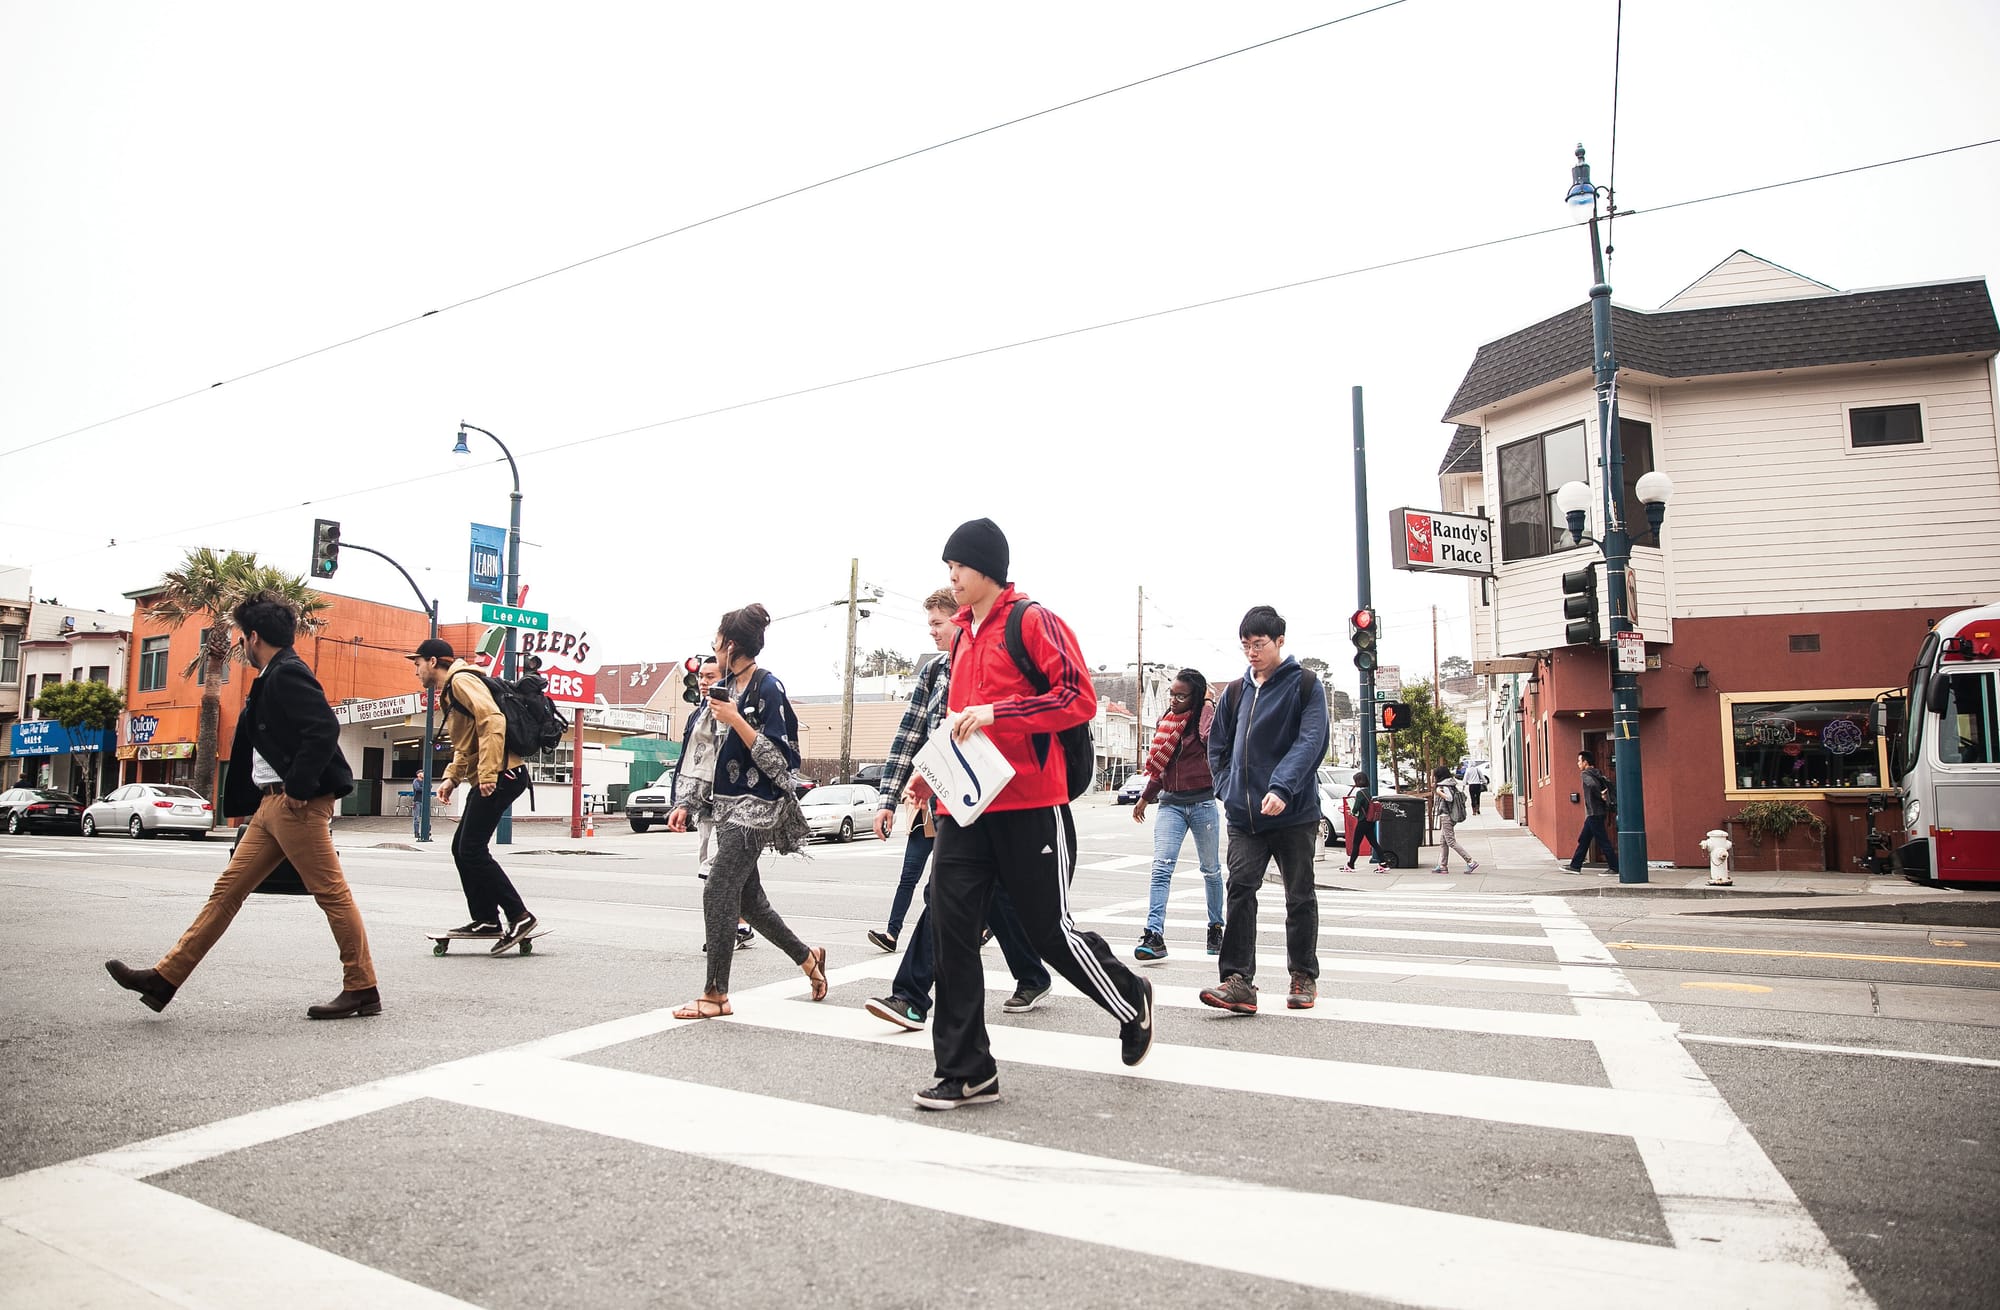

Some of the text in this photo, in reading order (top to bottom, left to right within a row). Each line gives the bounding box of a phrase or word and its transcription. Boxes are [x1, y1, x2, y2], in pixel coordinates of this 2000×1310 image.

[1433, 520, 1488, 546] Randy's
[1441, 544, 1482, 564] Place
[473, 551, 498, 577] LEARN
[492, 609, 538, 626] Lee Ave
[522, 631, 591, 664] BEEP'S
[1626, 656, 1638, 664] TIME
[357, 697, 406, 712] BEEP'S DRIVE IN
[372, 708, 391, 718] OCEAN
[132, 716, 158, 734] Quickly
[918, 761, 951, 800] STEWART
